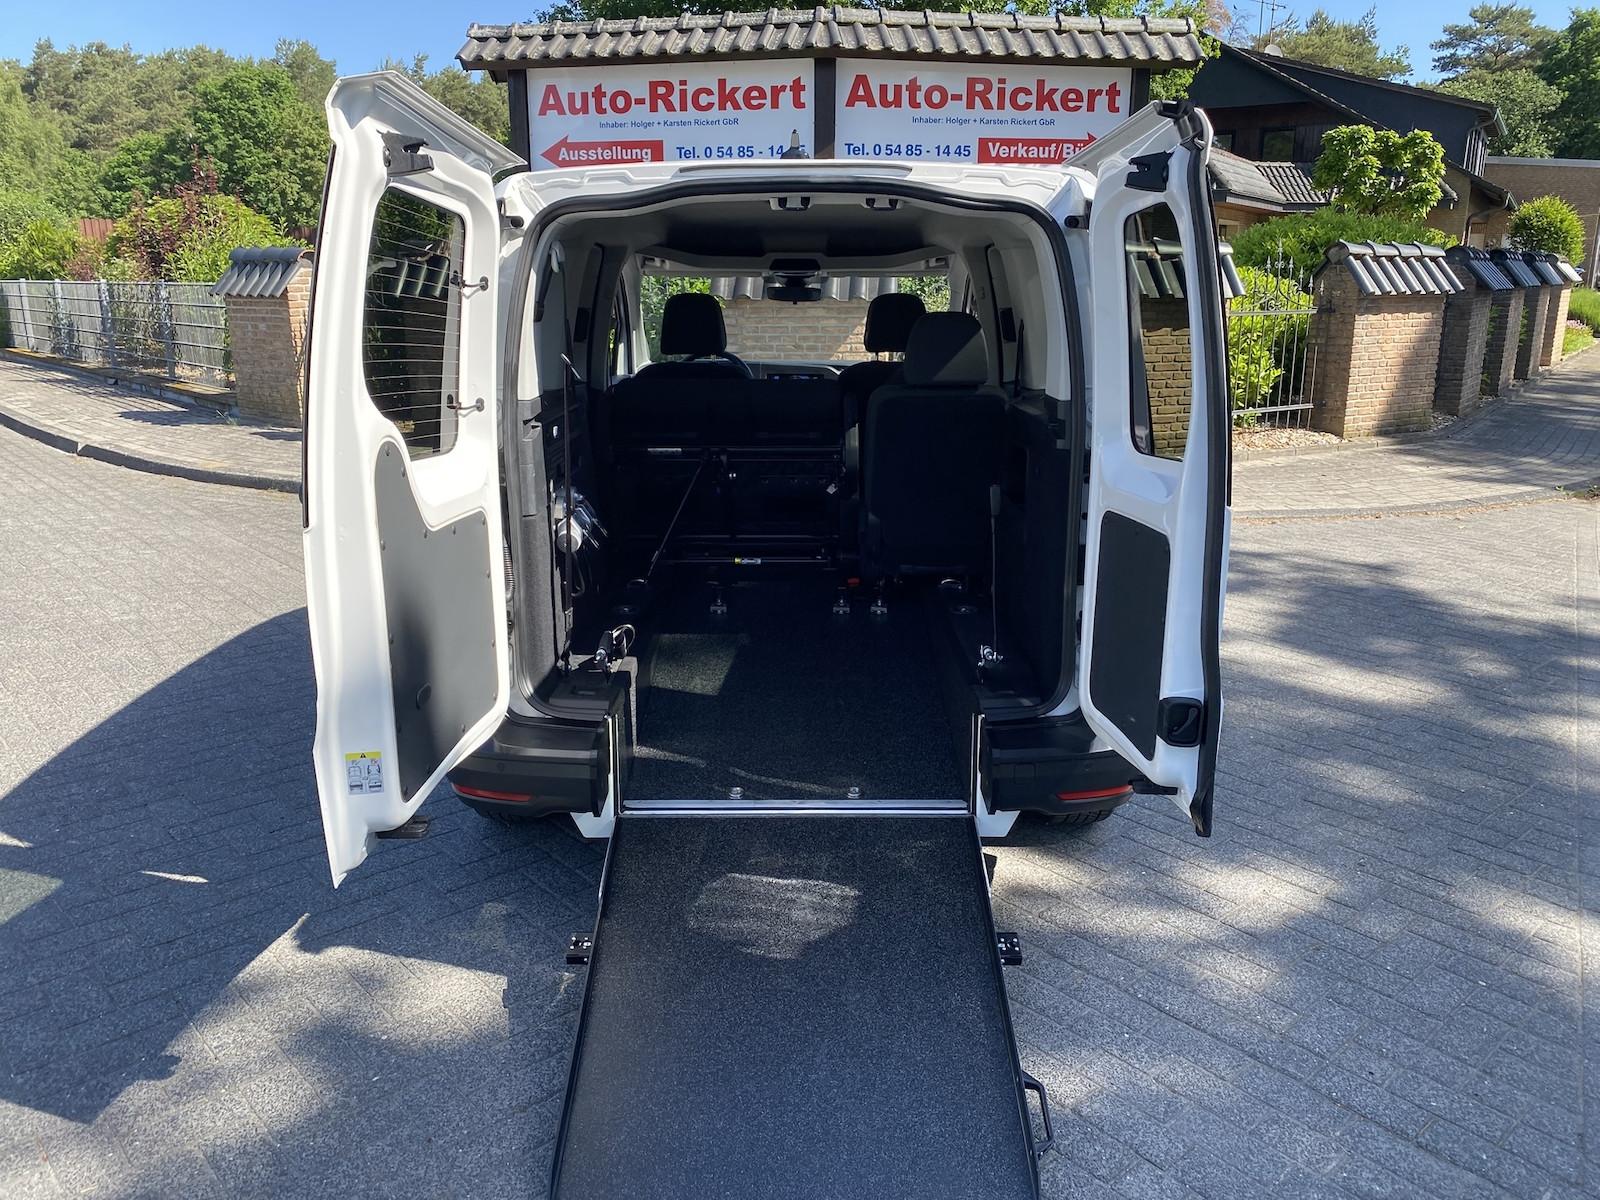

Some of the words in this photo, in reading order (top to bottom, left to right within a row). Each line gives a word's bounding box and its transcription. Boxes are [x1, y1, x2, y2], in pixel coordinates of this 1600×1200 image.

[537, 75, 806, 116] Auto-Rickert
[845, 74, 1121, 113] Auto-Rickert
[599, 121, 629, 129] Inhaber:
[630, 119, 655, 129] Holger
[663, 119, 692, 127] Karsten
[693, 118, 721, 127] Rickert
[722, 117, 739, 126] GbR
[912, 116, 944, 124] Inhaber:
[945, 117, 971, 126] Holger
[979, 117, 1009, 126] Karsten
[1010, 118, 1038, 126] Rickert
[1039, 118, 1056, 127] GbR
[558, 145, 652, 162] Ausstellung
[676, 146, 700, 159] Tel.
[845, 143, 870, 156] Tel.
